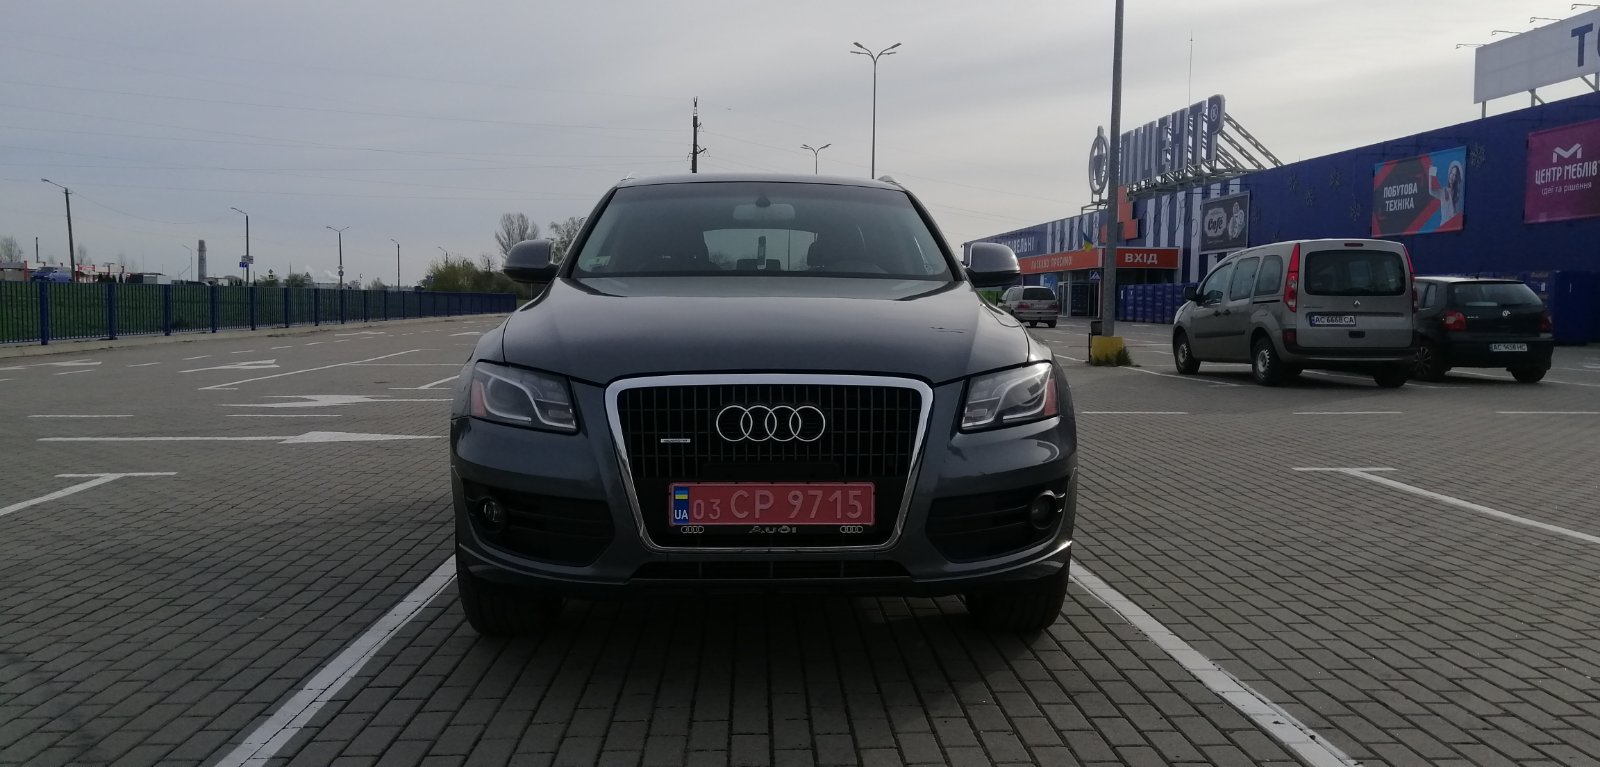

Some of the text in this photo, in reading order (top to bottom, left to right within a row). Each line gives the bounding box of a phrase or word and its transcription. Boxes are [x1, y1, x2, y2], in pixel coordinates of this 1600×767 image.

[1571, 23, 1600, 67] Т
[1535, 160, 1598, 185] ЦЕНТР МЕБЛІВ
[1383, 182, 1418, 198] ПОБУТОВА
[1555, 185, 1563, 193] та
[1564, 181, 1592, 194] рішення
[1385, 197, 1415, 212] ТЕХНІКА
[1125, 253, 1158, 264] ВХІД
[692, 490, 863, 520] 03 CP 9715
[674, 509, 689, 520] UA
